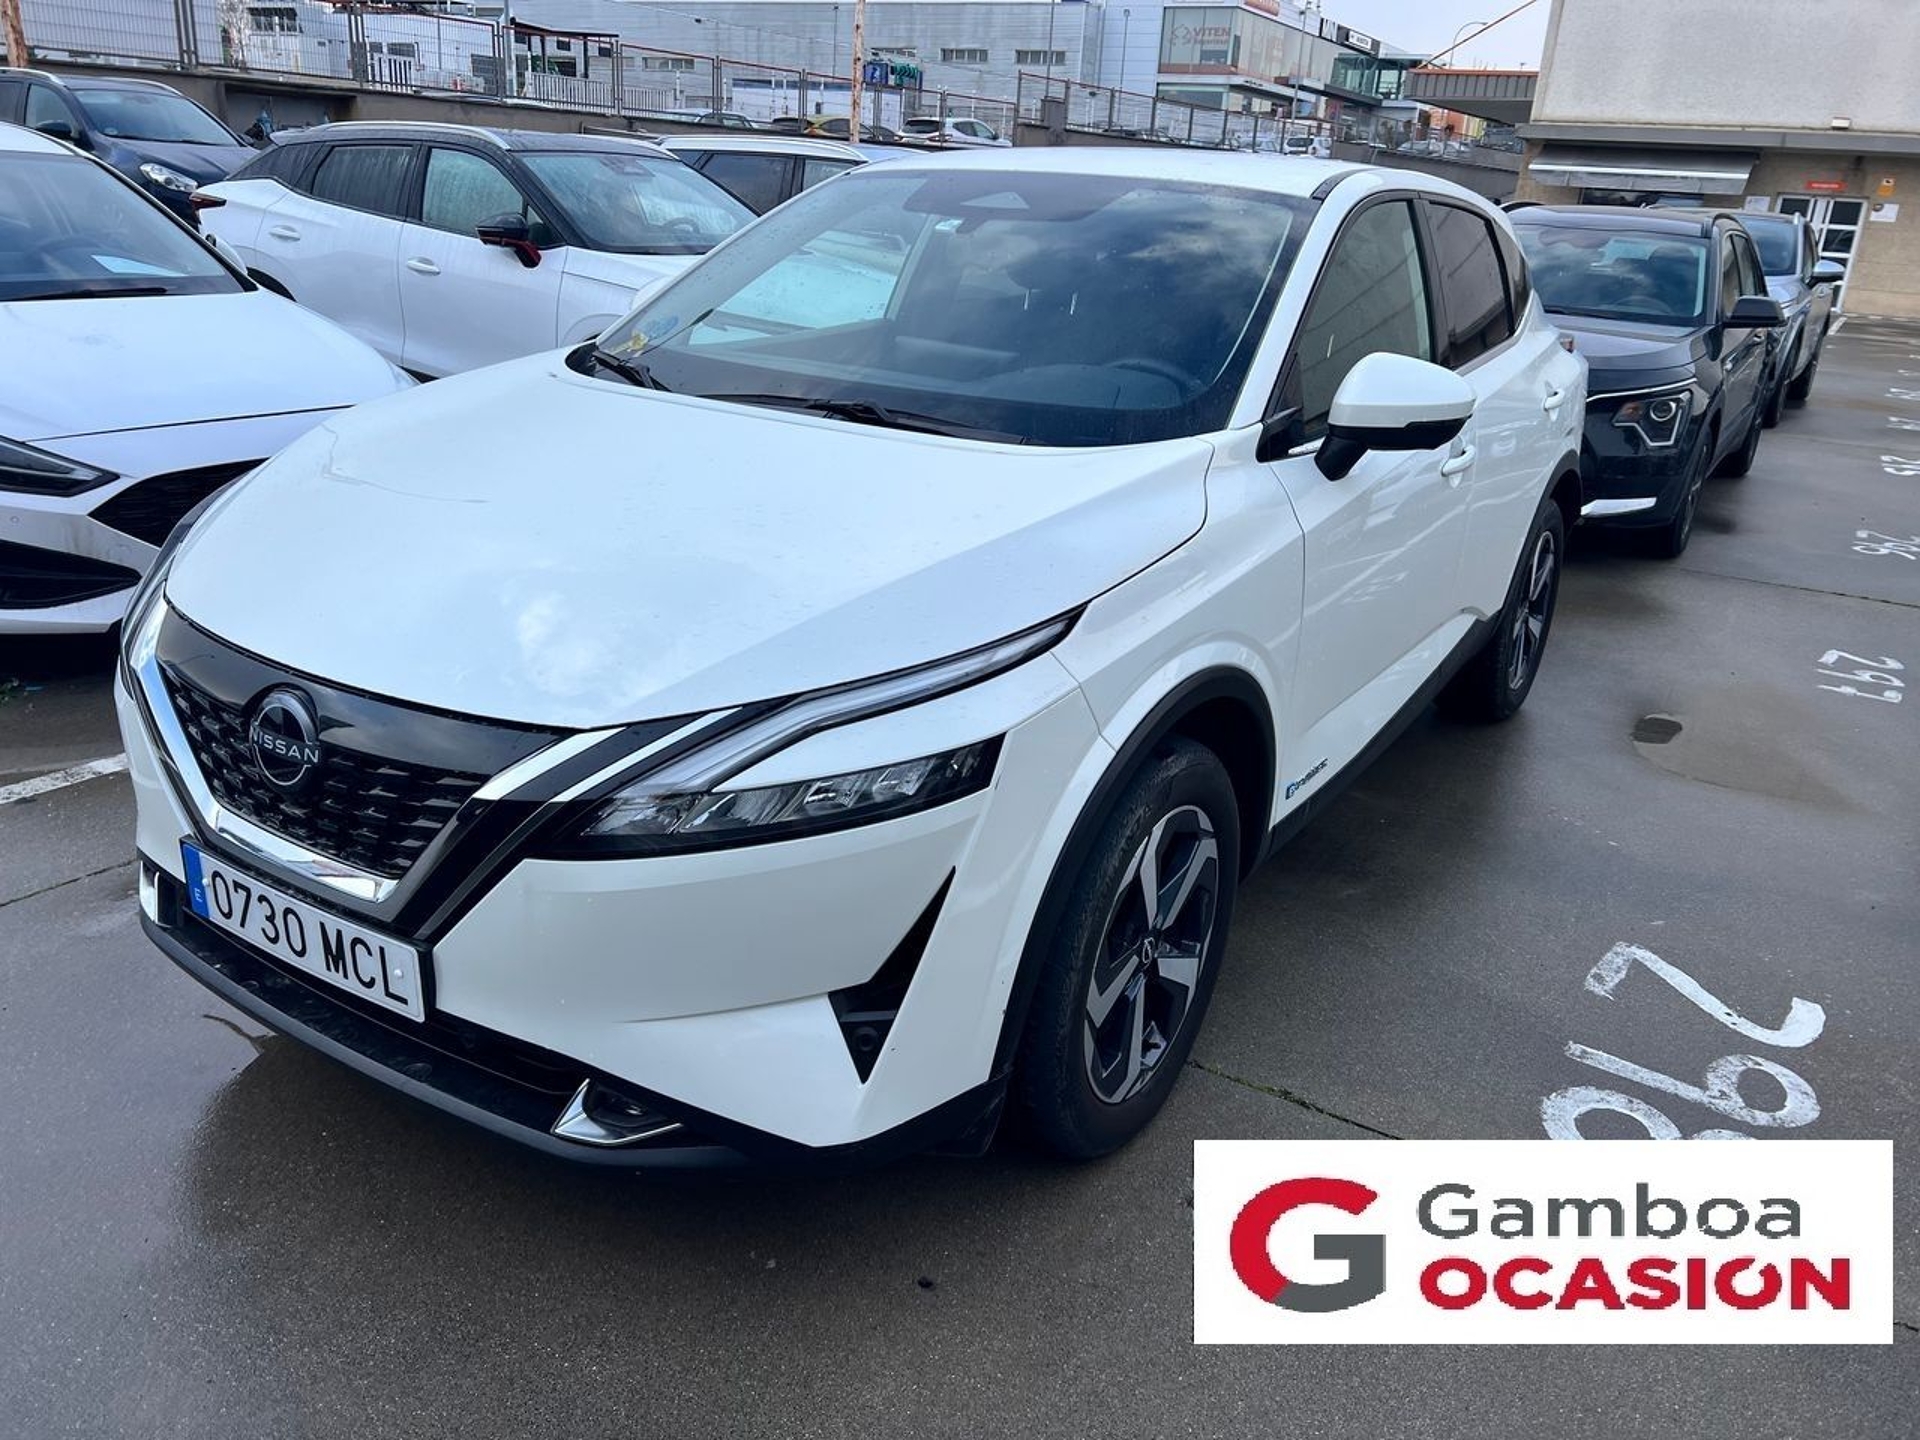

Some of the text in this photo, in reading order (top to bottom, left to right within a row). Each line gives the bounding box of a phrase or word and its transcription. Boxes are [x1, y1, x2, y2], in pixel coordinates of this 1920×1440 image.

[249, 722, 319, 763] NISSAN
[211, 869, 408, 1006] 0730 MCL
